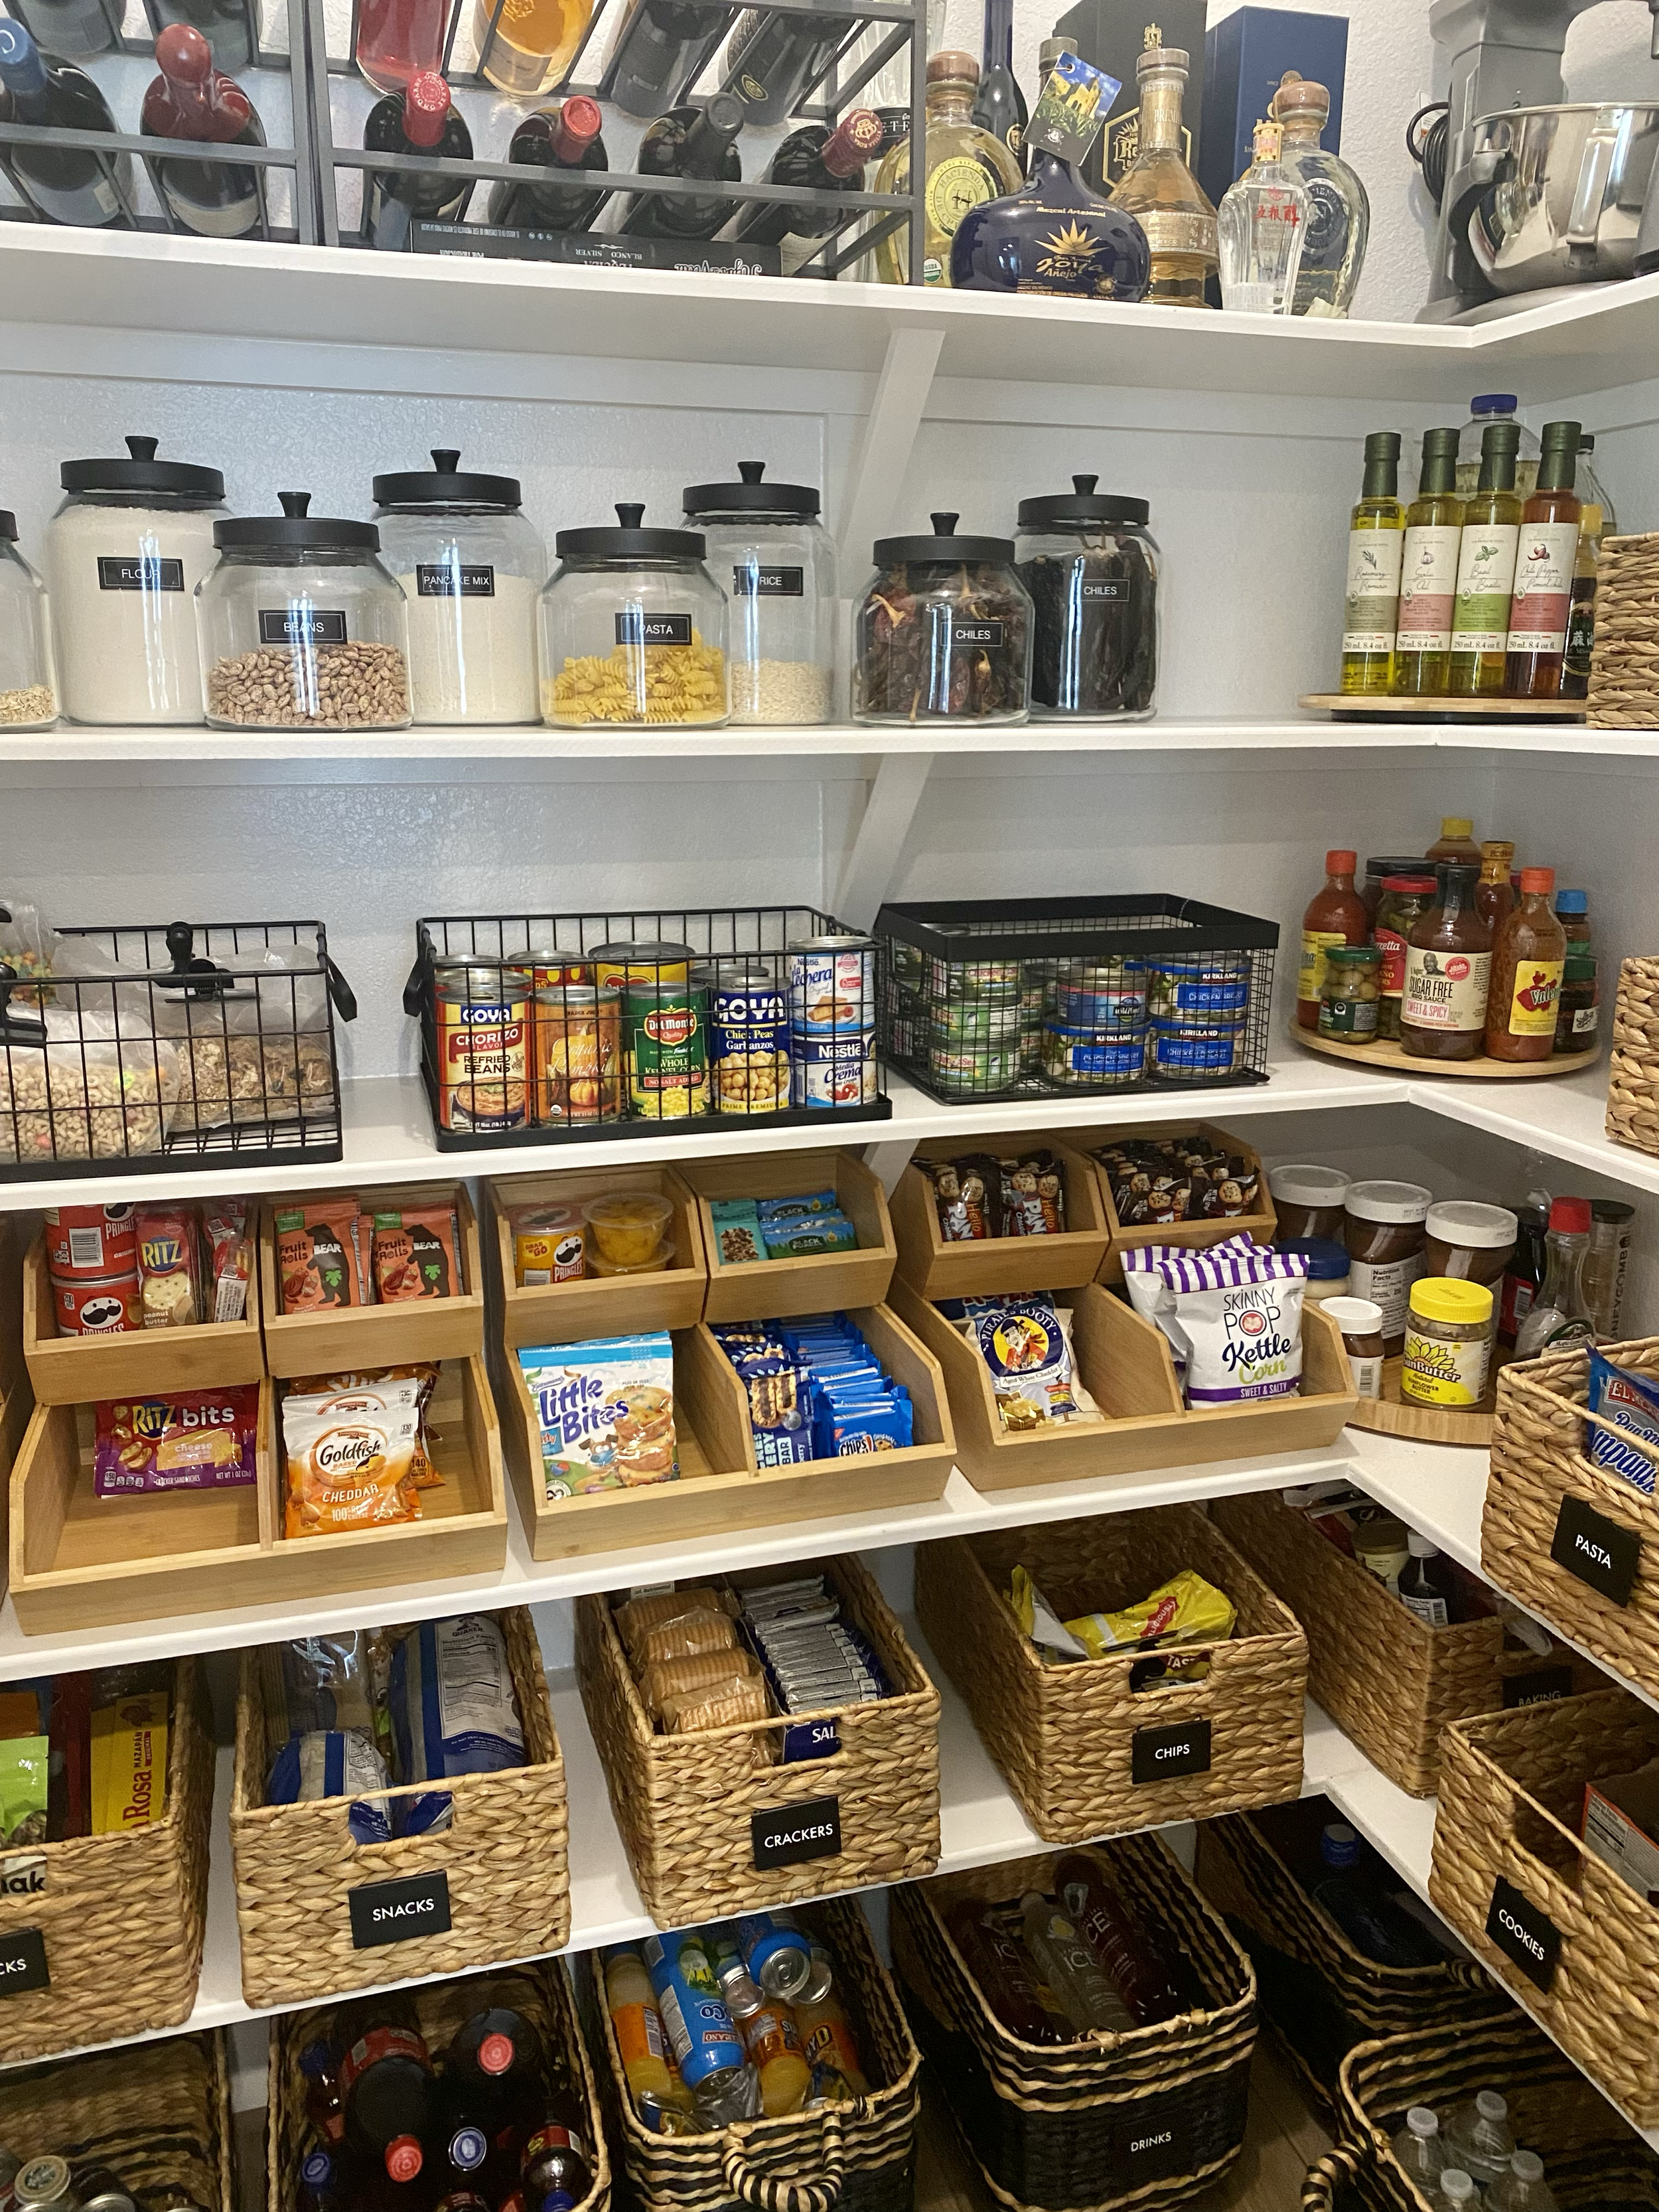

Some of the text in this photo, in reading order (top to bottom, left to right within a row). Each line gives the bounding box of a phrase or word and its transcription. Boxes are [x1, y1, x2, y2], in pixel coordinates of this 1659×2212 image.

[939, 169, 985, 190] HACIENDA
[1067, 208, 1106, 217] Artesanal
[1037, 258, 1104, 274] Joya
[1044, 267, 1078, 279] Añejo
[121, 569, 160, 579] FLOUR
[1470, 564, 1490, 577] Basil
[424, 575, 490, 586] PANCAKE MIX
[759, 575, 782, 586] RICE
[1084, 586, 1117, 595] CHILES
[283, 622, 324, 632] BEANS
[639, 625, 673, 634] PASTA
[956, 630, 991, 639] CHILES
[1409, 976, 1454, 998] SUGAR FREE
[463, 1008, 511, 1023] GOYA
[714, 997, 785, 1023] GOYA
[1407, 1000, 1447, 1018] SWEET & SPICY
[666, 1018, 694, 1029] Mone
[456, 1029, 518, 1046] CHORIZO
[754, 1029, 774, 1039] Peas
[464, 1055, 510, 1064] REFRIED
[660, 1058, 689, 1068] WHOLE
[835, 1063, 855, 1071] Media
[465, 1063, 510, 1073] BEANS
[824, 1067, 862, 1083] Crema
[948, 1202, 974, 1239] PAN
[967, 1203, 980, 1232] Hello
[1023, 1197, 1046, 1233] PAN
[1042, 1200, 1054, 1228] Hello
[279, 1241, 307, 1252] Fruit
[314, 1243, 342, 1254] BEAR
[378, 1239, 406, 1251] Fruit
[413, 1242, 440, 1250] BEAR
[534, 1246, 547, 1256] GO
[141, 1240, 182, 1267] RITZ
[281, 1252, 308, 1264] Rolls
[379, 1249, 408, 1261] Rolls
[555, 1260, 583, 1282] PRINGLES
[1224, 1287, 1275, 1311] SKINNY
[143, 1311, 169, 1319] peanut
[1224, 1306, 1281, 1340] POP
[1222, 1333, 1291, 1372] Kettle
[1036, 1367, 1058, 1378] Cheddar
[1239, 1359, 1287, 1384] Corn
[1404, 1359, 1461, 1382] SunButter
[1241, 1382, 1287, 1398] SWEET & SALTY
[1408, 1378, 1439, 1391] SUNFLOWER
[1412, 1384, 1431, 1394] BUTTER
[1611, 1380, 1630, 1400] EL
[540, 1376, 603, 1427] Little
[133, 1405, 234, 1434] RITZ bits
[564, 1400, 628, 1444] Bites
[175, 1443, 212, 1452] cheese
[321, 1440, 380, 1465] Goldfish
[782, 1442, 792, 1465] BAR
[839, 1438, 867, 1457] Chips
[412, 1458, 426, 1467] 140
[175, 1475, 200, 1484] SANDWICHES
[323, 1484, 379, 1503] CHEDDAR
[1575, 1534, 1611, 1569] PASTA
[452, 1628, 483, 1637] QUAKER
[1518, 1690, 1561, 1708] BAKING
[133, 1732, 143, 1767] MAZAPÁN
[1155, 1744, 1190, 1760] CHIPS
[123, 1771, 152, 1821] Rosa
[764, 1824, 833, 1849] CRACKERS
[372, 1898, 435, 1921] SNACKS
[1498, 1909, 1545, 1961] COOKIES
[1131, 2131, 1172, 2152] DRINKS
